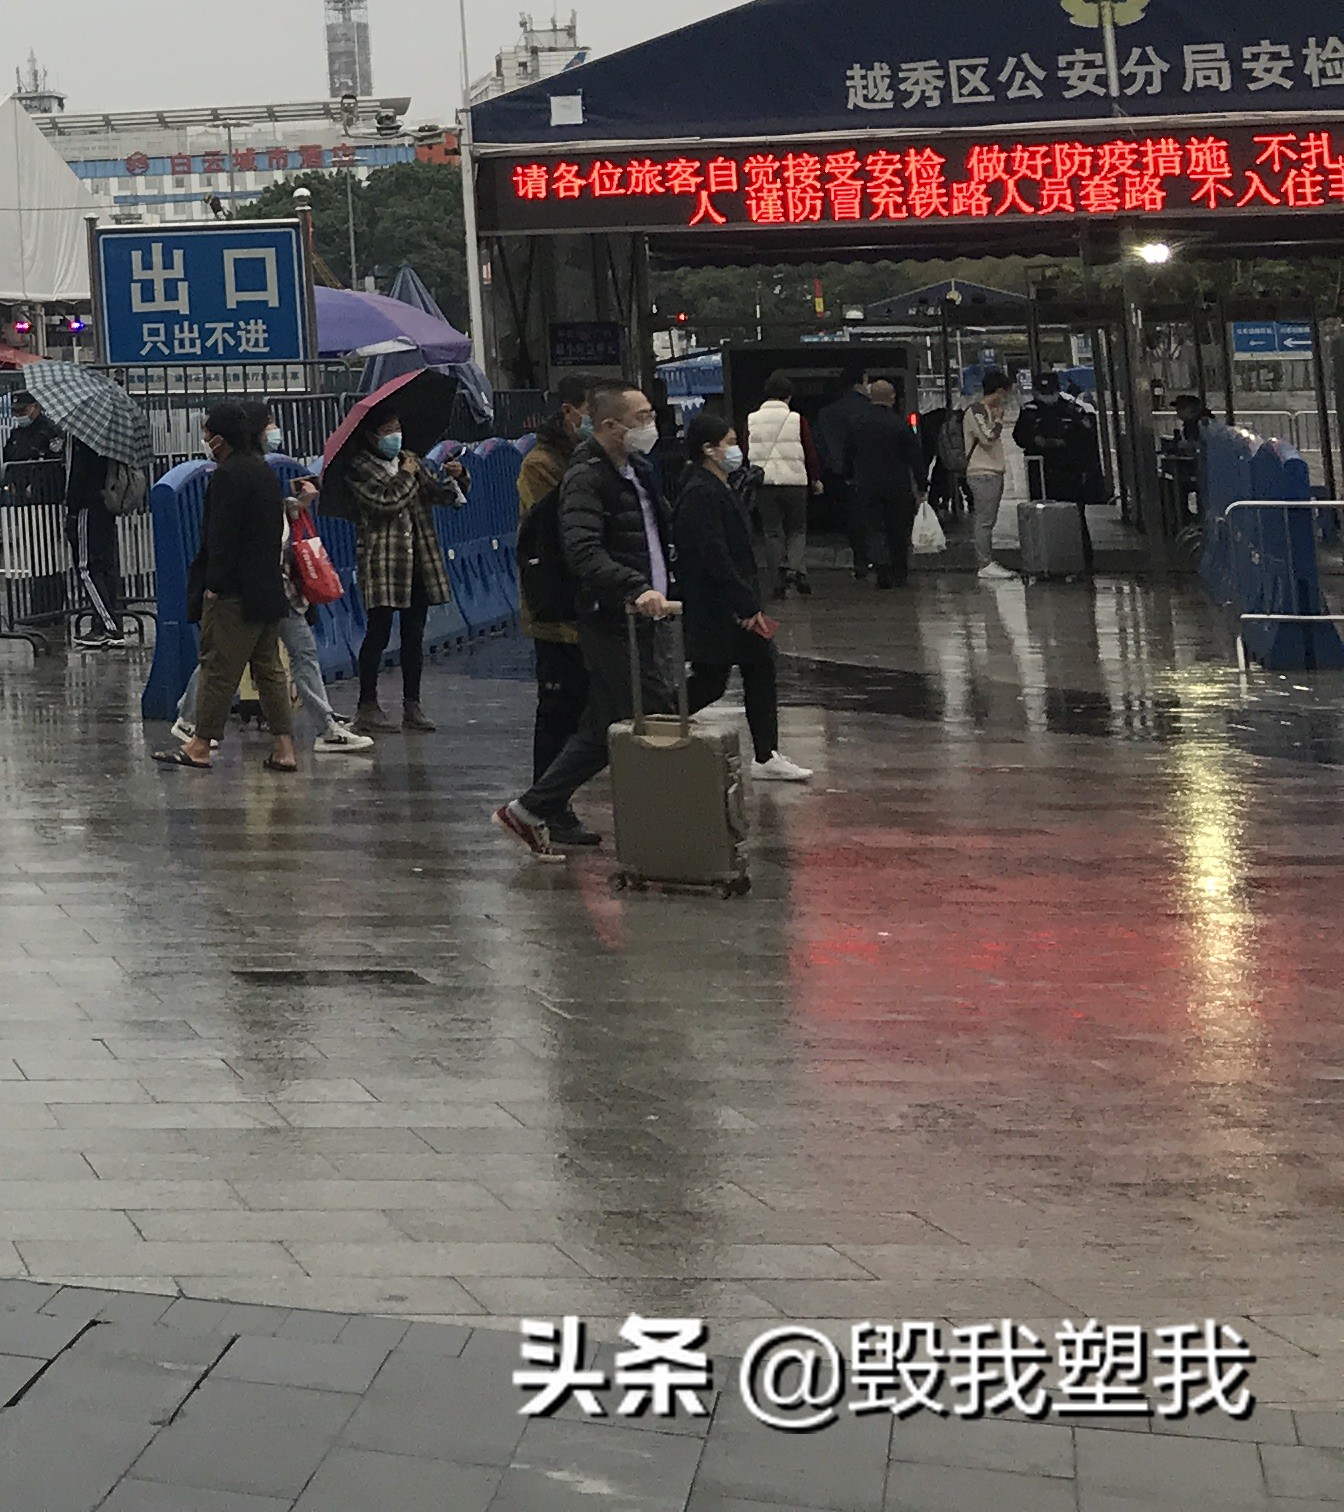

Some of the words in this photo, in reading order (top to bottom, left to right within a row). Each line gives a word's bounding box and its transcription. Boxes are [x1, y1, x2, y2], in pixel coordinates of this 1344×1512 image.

[512, 147, 946, 200] 请各位旅客自觉接受安检
[967, 136, 1232, 181] 做好防疫措施
[689, 189, 727, 227] 人
[745, 174, 1168, 223] 谨防冒充铁路人员套路
[130, 242, 280, 315] 出口
[140, 319, 270, 356] 只出不进
